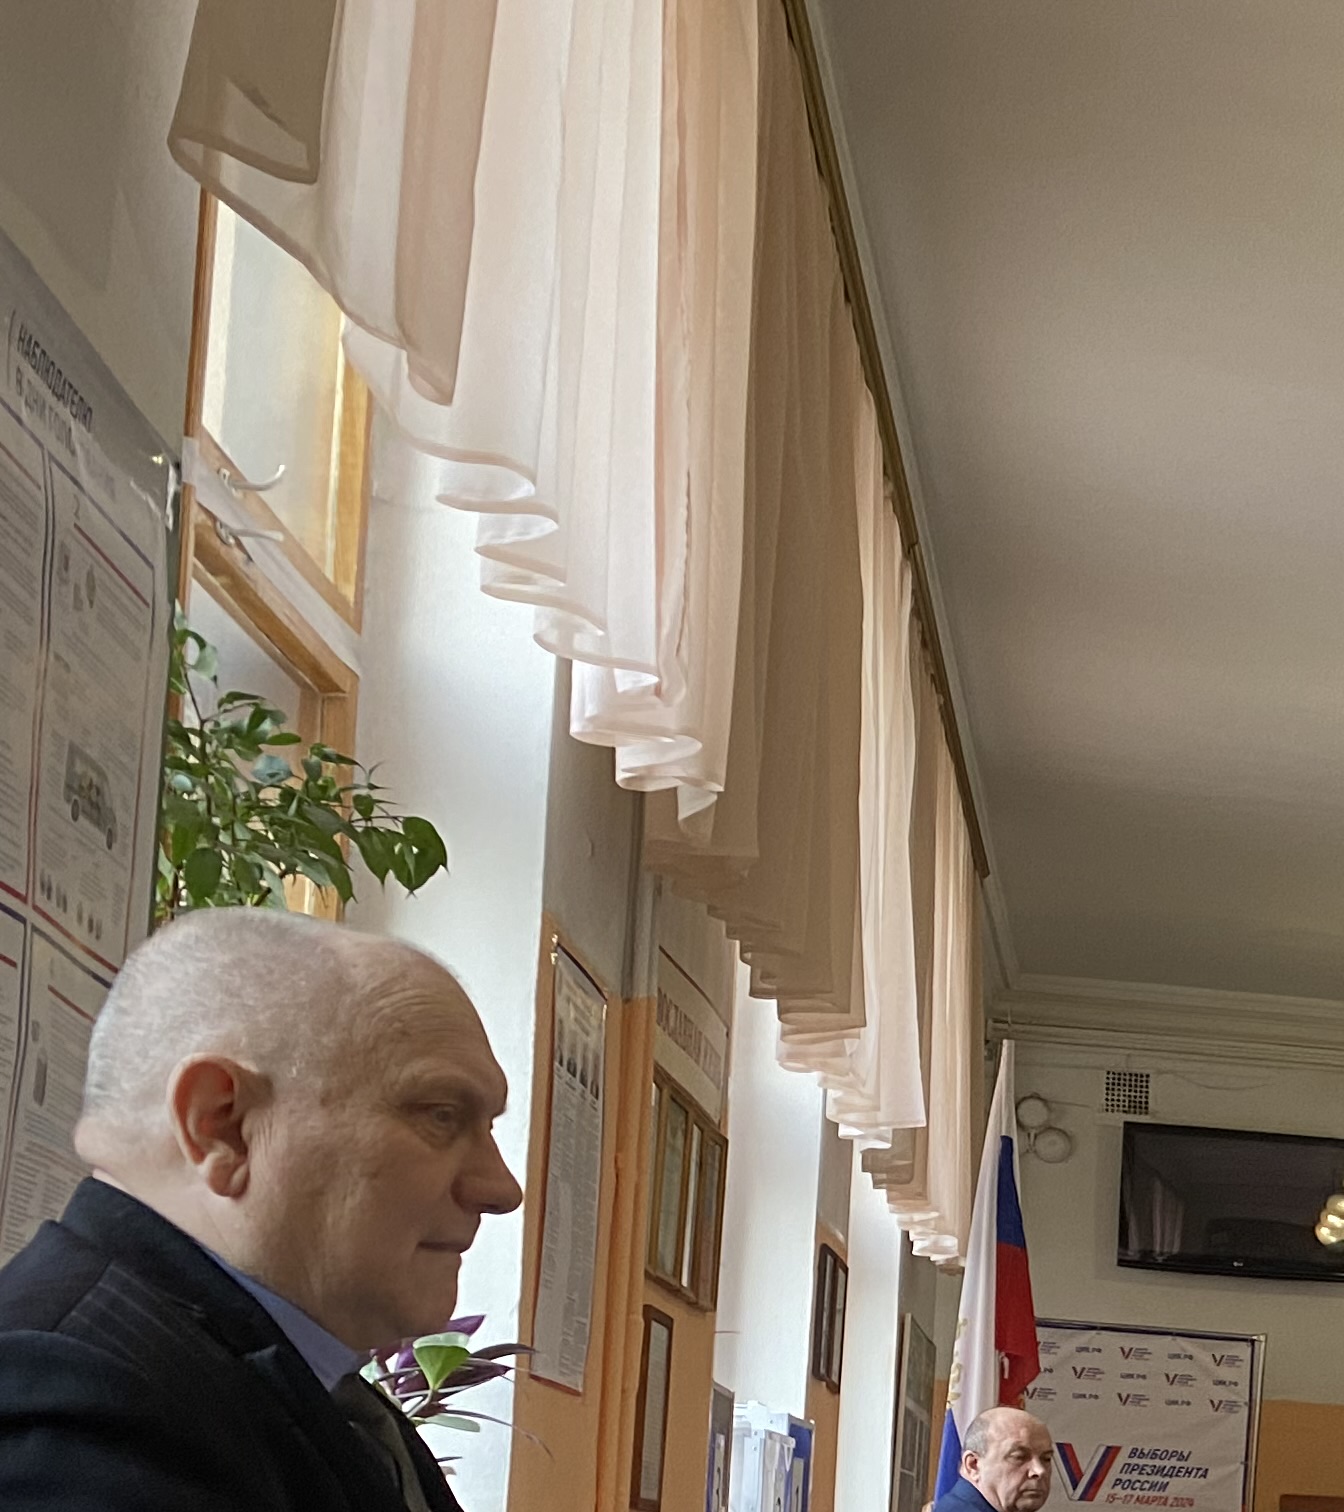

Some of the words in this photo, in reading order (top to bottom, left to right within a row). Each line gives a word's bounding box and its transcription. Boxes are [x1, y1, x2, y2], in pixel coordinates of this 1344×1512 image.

[17, 322, 93, 433] НАБЛЮДАТЕЛЮ
[1128, 1447, 1192, 1462] ВЫБОРЫ
[1120, 1463, 1209, 1479] ПРЕЗИДЕНТА
[1111, 1478, 1169, 1492] РОССИИ
[1135, 1495, 1168, 1507] МАРТА
